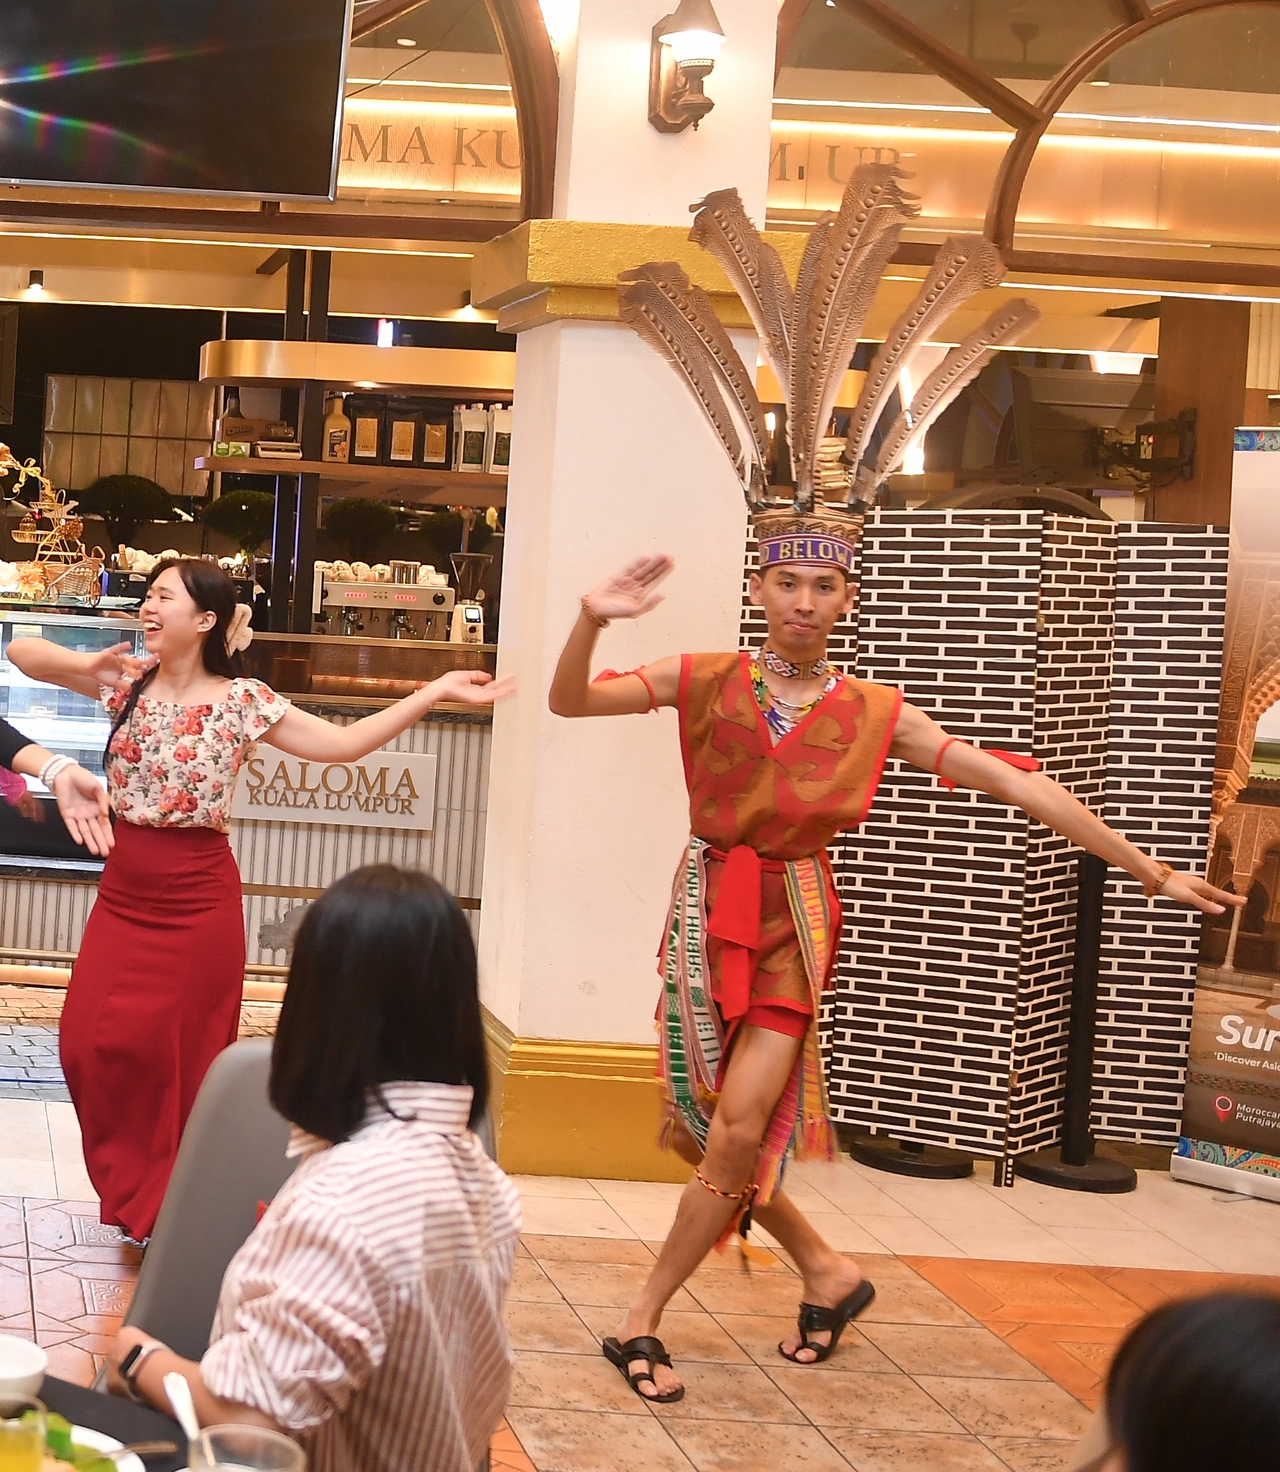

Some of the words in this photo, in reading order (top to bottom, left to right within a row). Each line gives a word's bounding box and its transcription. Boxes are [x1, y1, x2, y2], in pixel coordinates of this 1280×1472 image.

[779, 540, 848, 564] BELOW
[245, 758, 420, 799] SALOMA
[248, 787, 319, 810] KUALA
[323, 793, 415, 816] LUMPUR
[687, 857, 699, 908] LAND
[687, 916, 703, 978] SABAH
